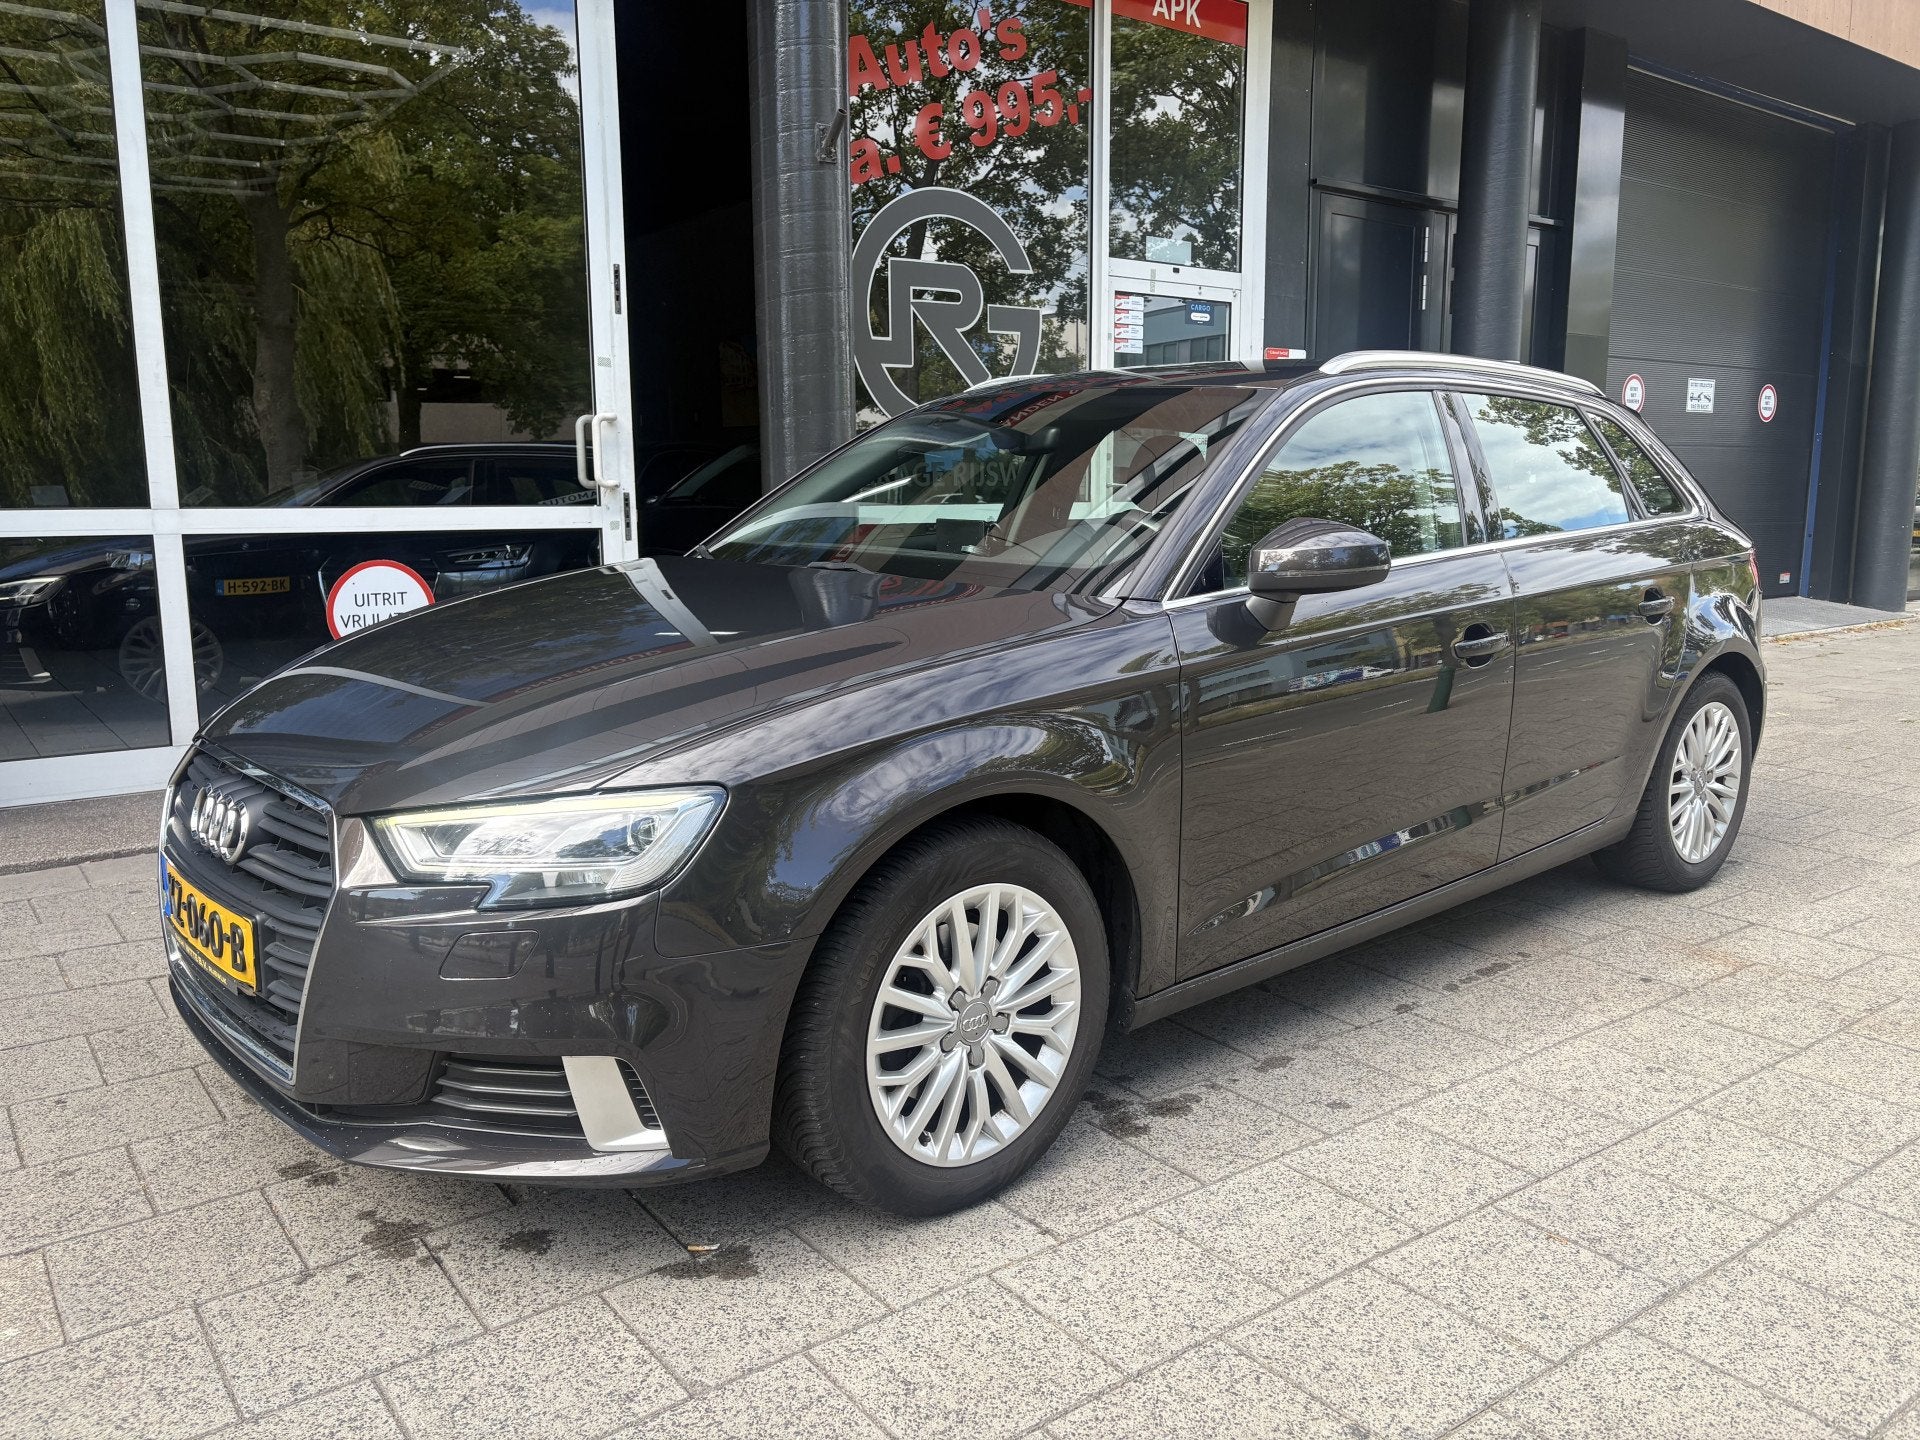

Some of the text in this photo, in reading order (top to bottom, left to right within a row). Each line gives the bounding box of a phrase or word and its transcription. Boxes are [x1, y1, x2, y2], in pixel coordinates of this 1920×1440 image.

[1152, 0, 1201, 28] APK
[849, 8, 1027, 96] Auto's
[1190, 303, 1211, 312] CARGO
[227, 580, 287, 594] H-592-BK
[354, 591, 408, 607] UITRIT
